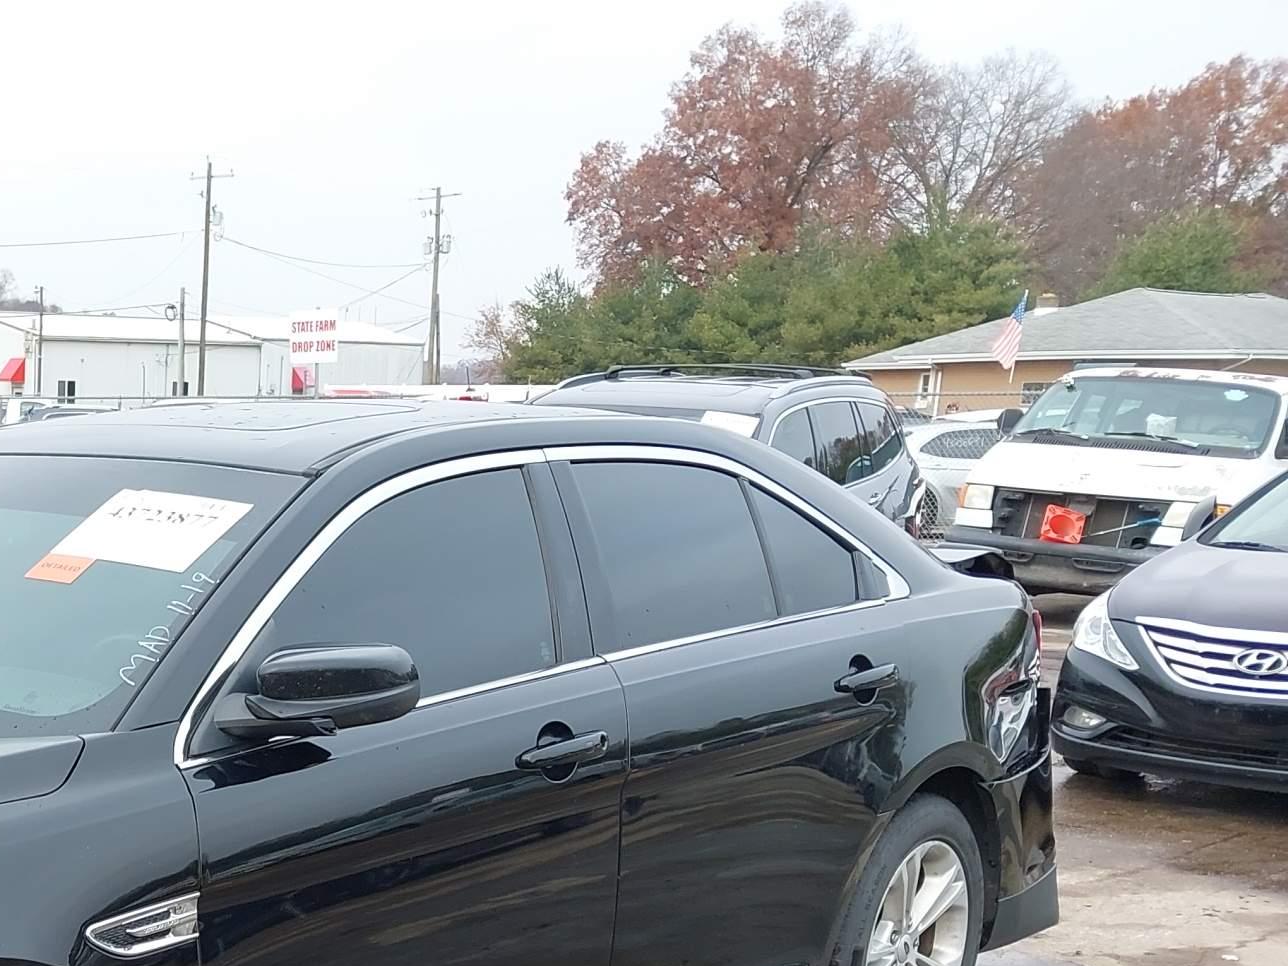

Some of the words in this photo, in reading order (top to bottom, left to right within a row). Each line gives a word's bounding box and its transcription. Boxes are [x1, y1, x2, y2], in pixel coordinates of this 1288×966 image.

[292, 321, 313, 333] STATE
[315, 320, 336, 331] FARM
[292, 341, 313, 352] DROP
[315, 340, 336, 352] ZONE
[119, 625, 170, 686] MAD
